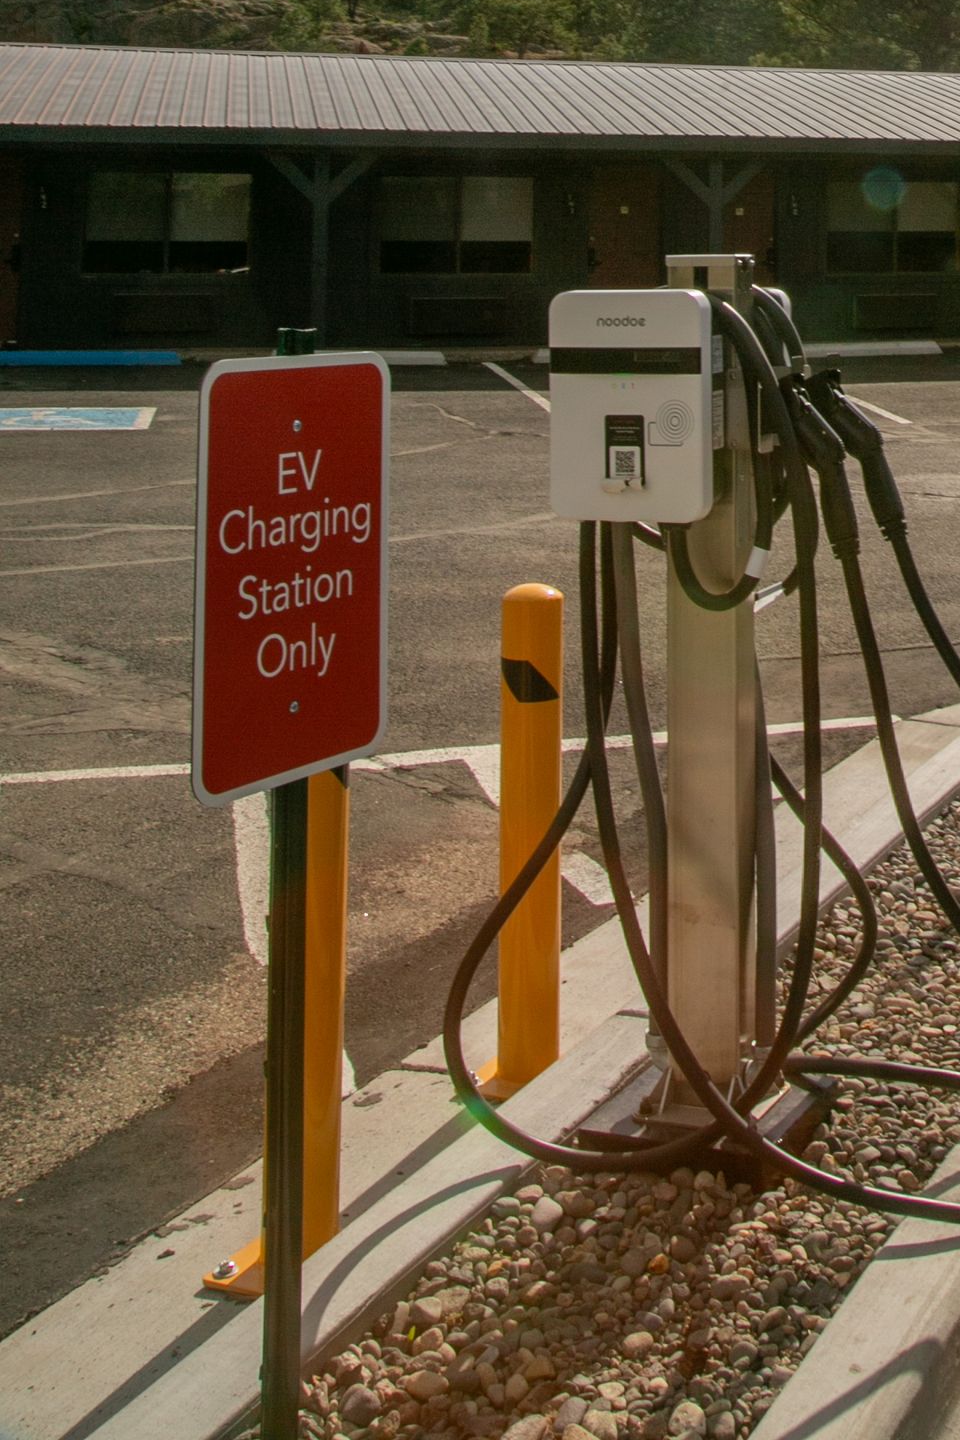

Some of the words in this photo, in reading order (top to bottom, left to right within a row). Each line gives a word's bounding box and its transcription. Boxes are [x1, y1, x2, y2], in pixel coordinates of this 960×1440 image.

[596, 316, 646, 327] noodoe
[278, 449, 322, 495] EV
[219, 497, 371, 554] Charging
[238, 566, 353, 620] Station
[257, 622, 336, 678] Only
